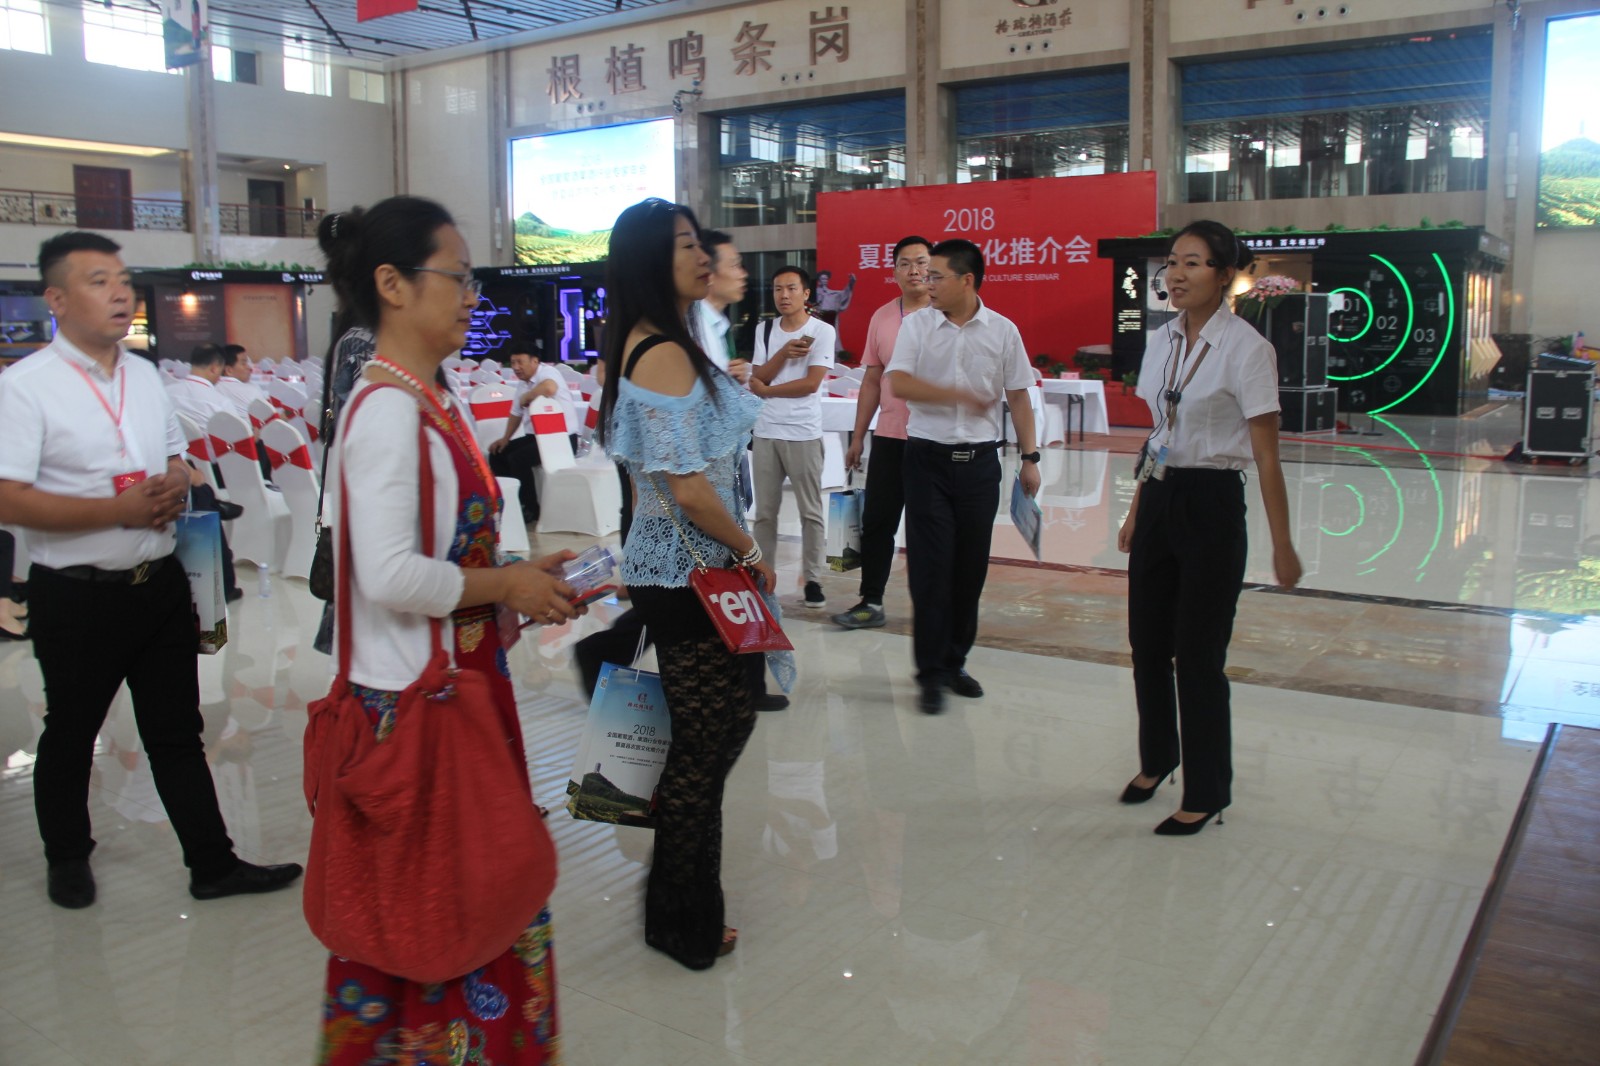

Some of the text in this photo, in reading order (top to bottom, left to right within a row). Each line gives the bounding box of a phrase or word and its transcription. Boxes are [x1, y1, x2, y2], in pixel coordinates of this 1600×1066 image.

[546, 6, 849, 103] 根植鸣条岗
[944, 207, 995, 232] 2018
[988, 274, 1023, 282] CULTURE
[1024, 273, 1060, 281] SEMINAR
[1375, 316, 1398, 329] 02
[1413, 329, 1436, 342] 03
[633, 724, 656, 737] 2018
